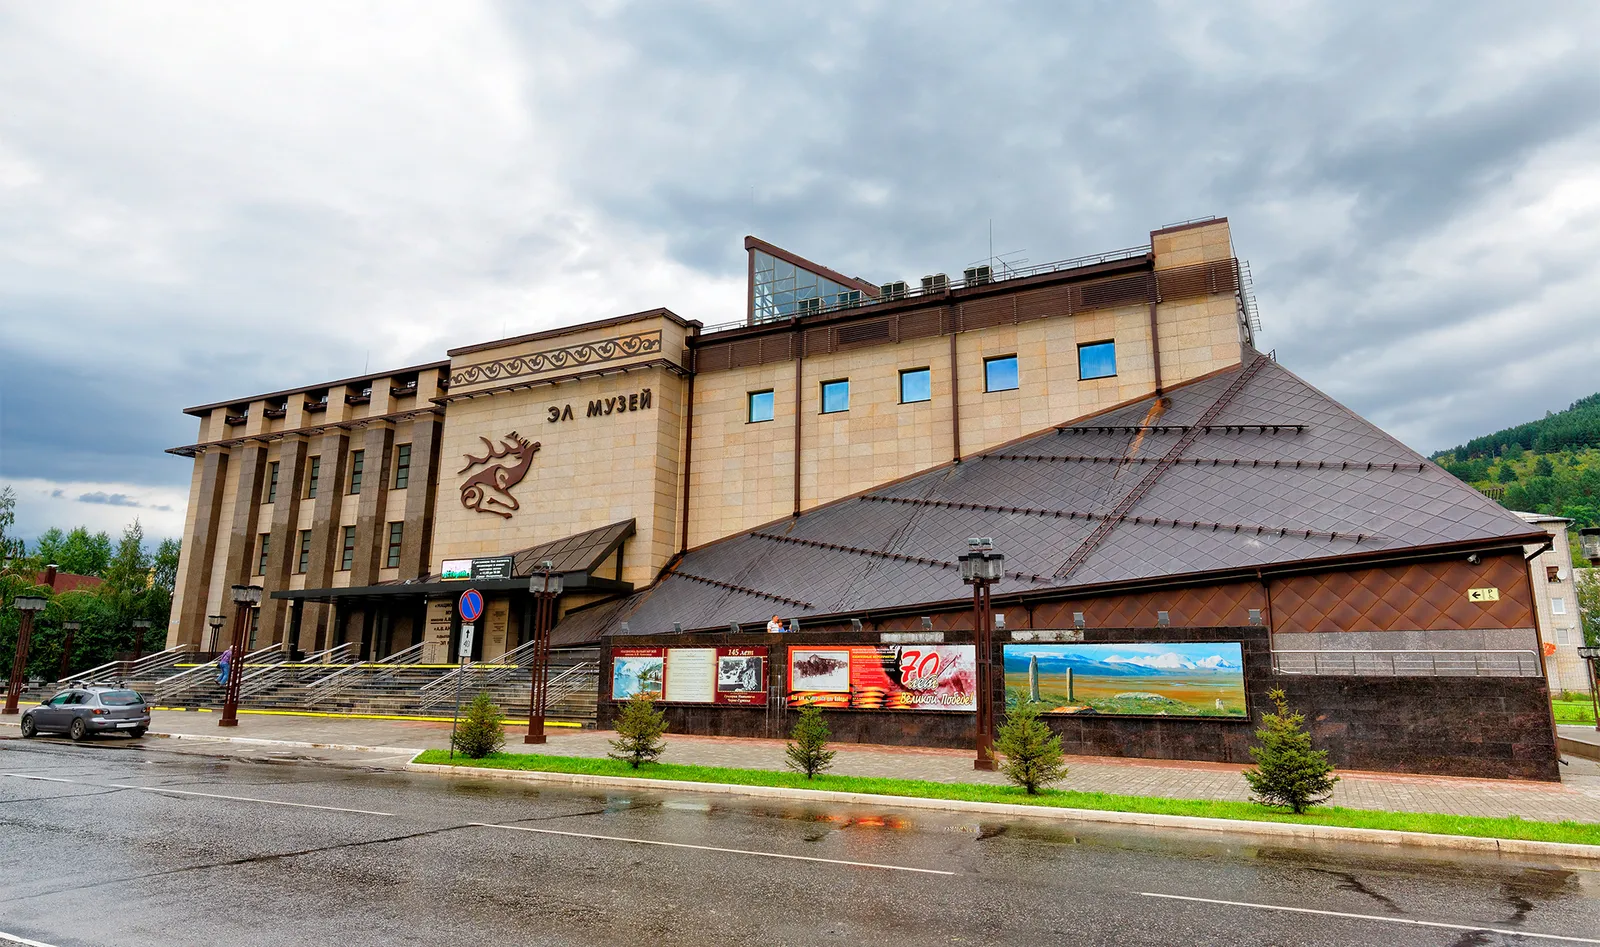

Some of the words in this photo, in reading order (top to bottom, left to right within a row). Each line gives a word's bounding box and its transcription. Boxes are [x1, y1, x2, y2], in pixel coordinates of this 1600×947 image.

[547, 404, 574, 422] ЭЛ
[586, 388, 652, 417] МУЗЕЙ
[900, 650, 939, 685] 70
[908, 674, 938, 689] лет
[900, 692, 937, 704] Великой
[941, 692, 974, 705] Победе!
